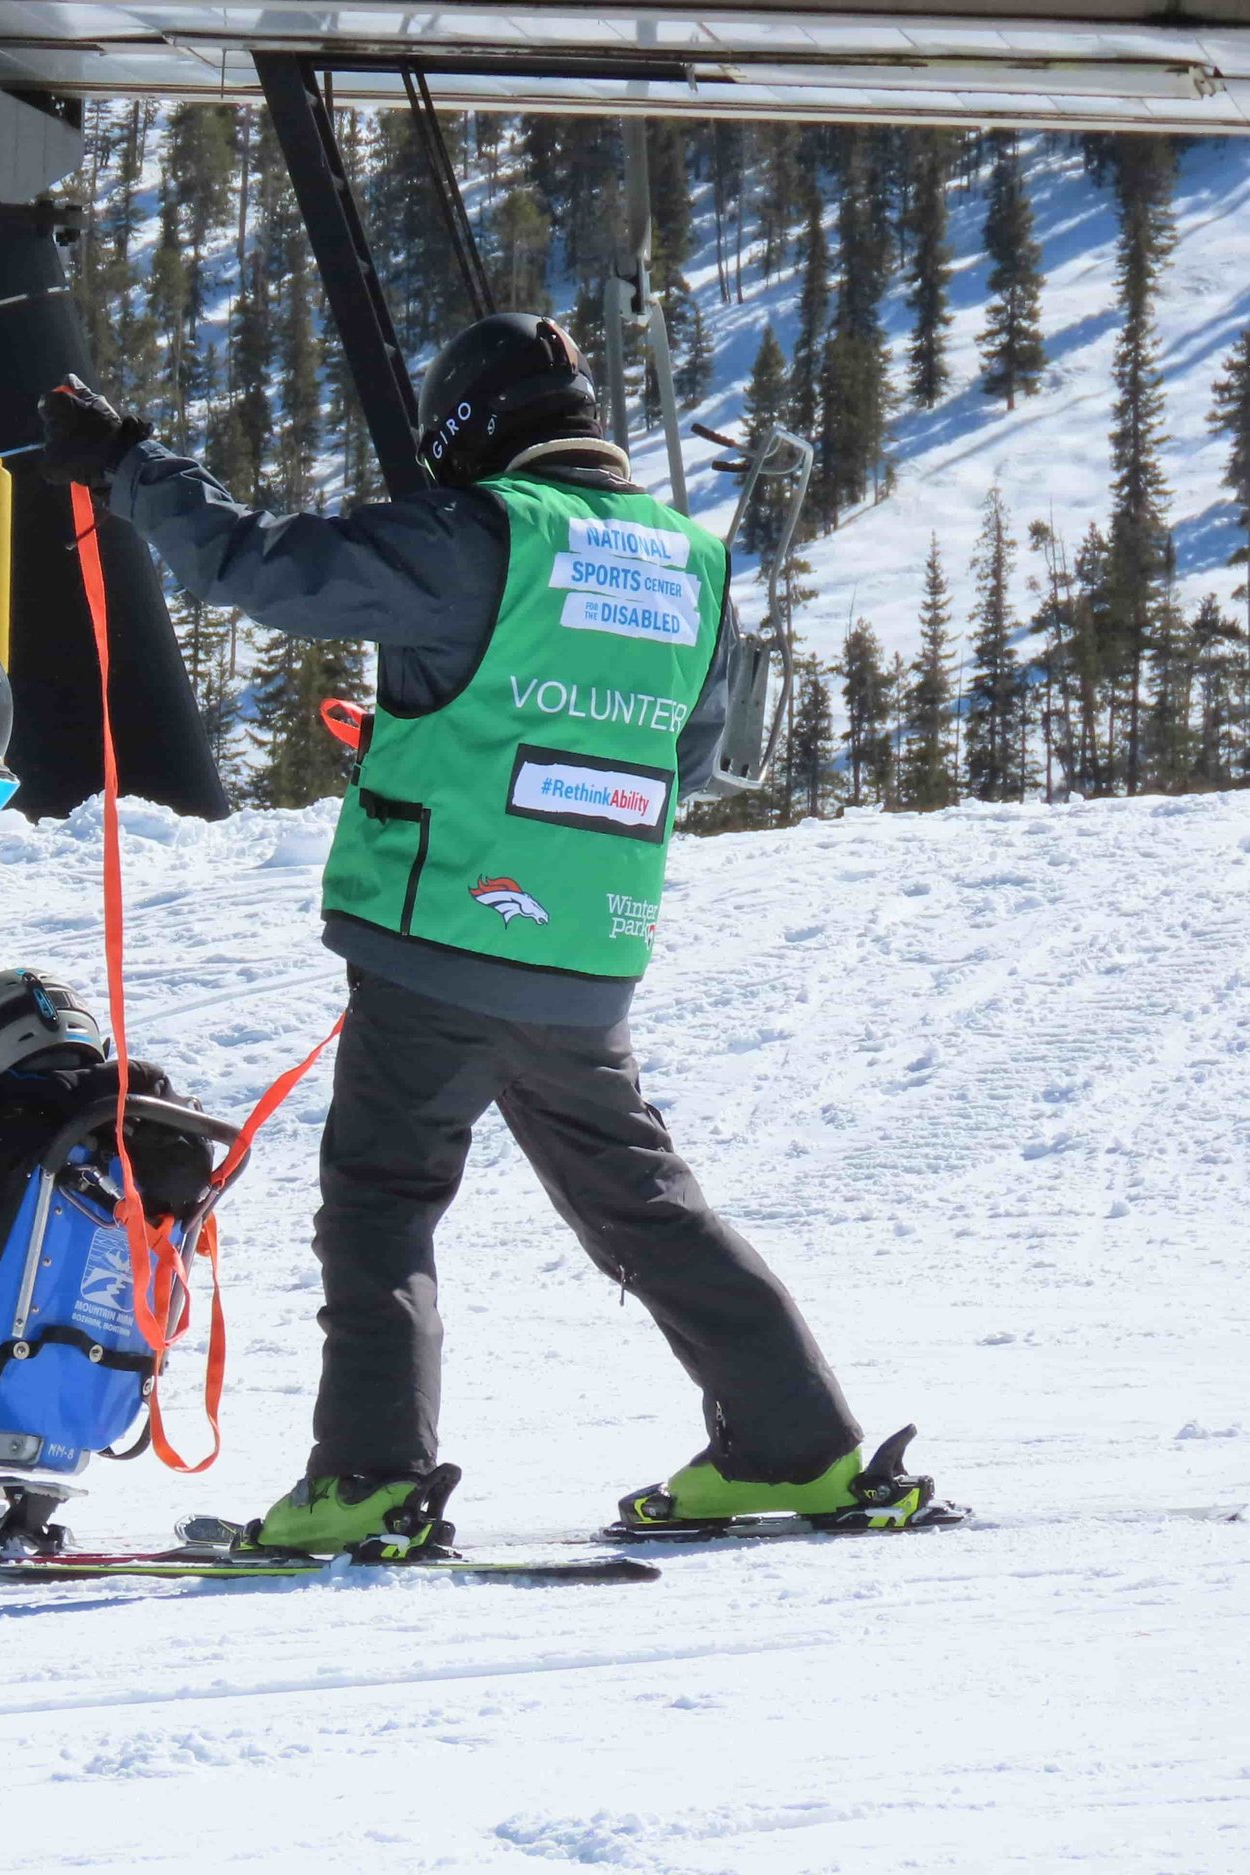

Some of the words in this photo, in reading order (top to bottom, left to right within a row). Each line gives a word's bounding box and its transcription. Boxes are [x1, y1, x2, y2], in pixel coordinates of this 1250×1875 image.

[432, 402, 472, 459] GIRO
[586, 526, 672, 560] NATIONAL
[571, 560, 642, 592] SPORTS
[644, 577, 682, 597] CENTER
[584, 610, 599, 621] THE
[585, 601, 599, 611] FOR
[601, 602, 681, 634] DISABLED
[510, 675, 688, 733] VOLUNTER
[541, 777, 650, 817] #RethinkAbility
[606, 893, 658, 920] Winter
